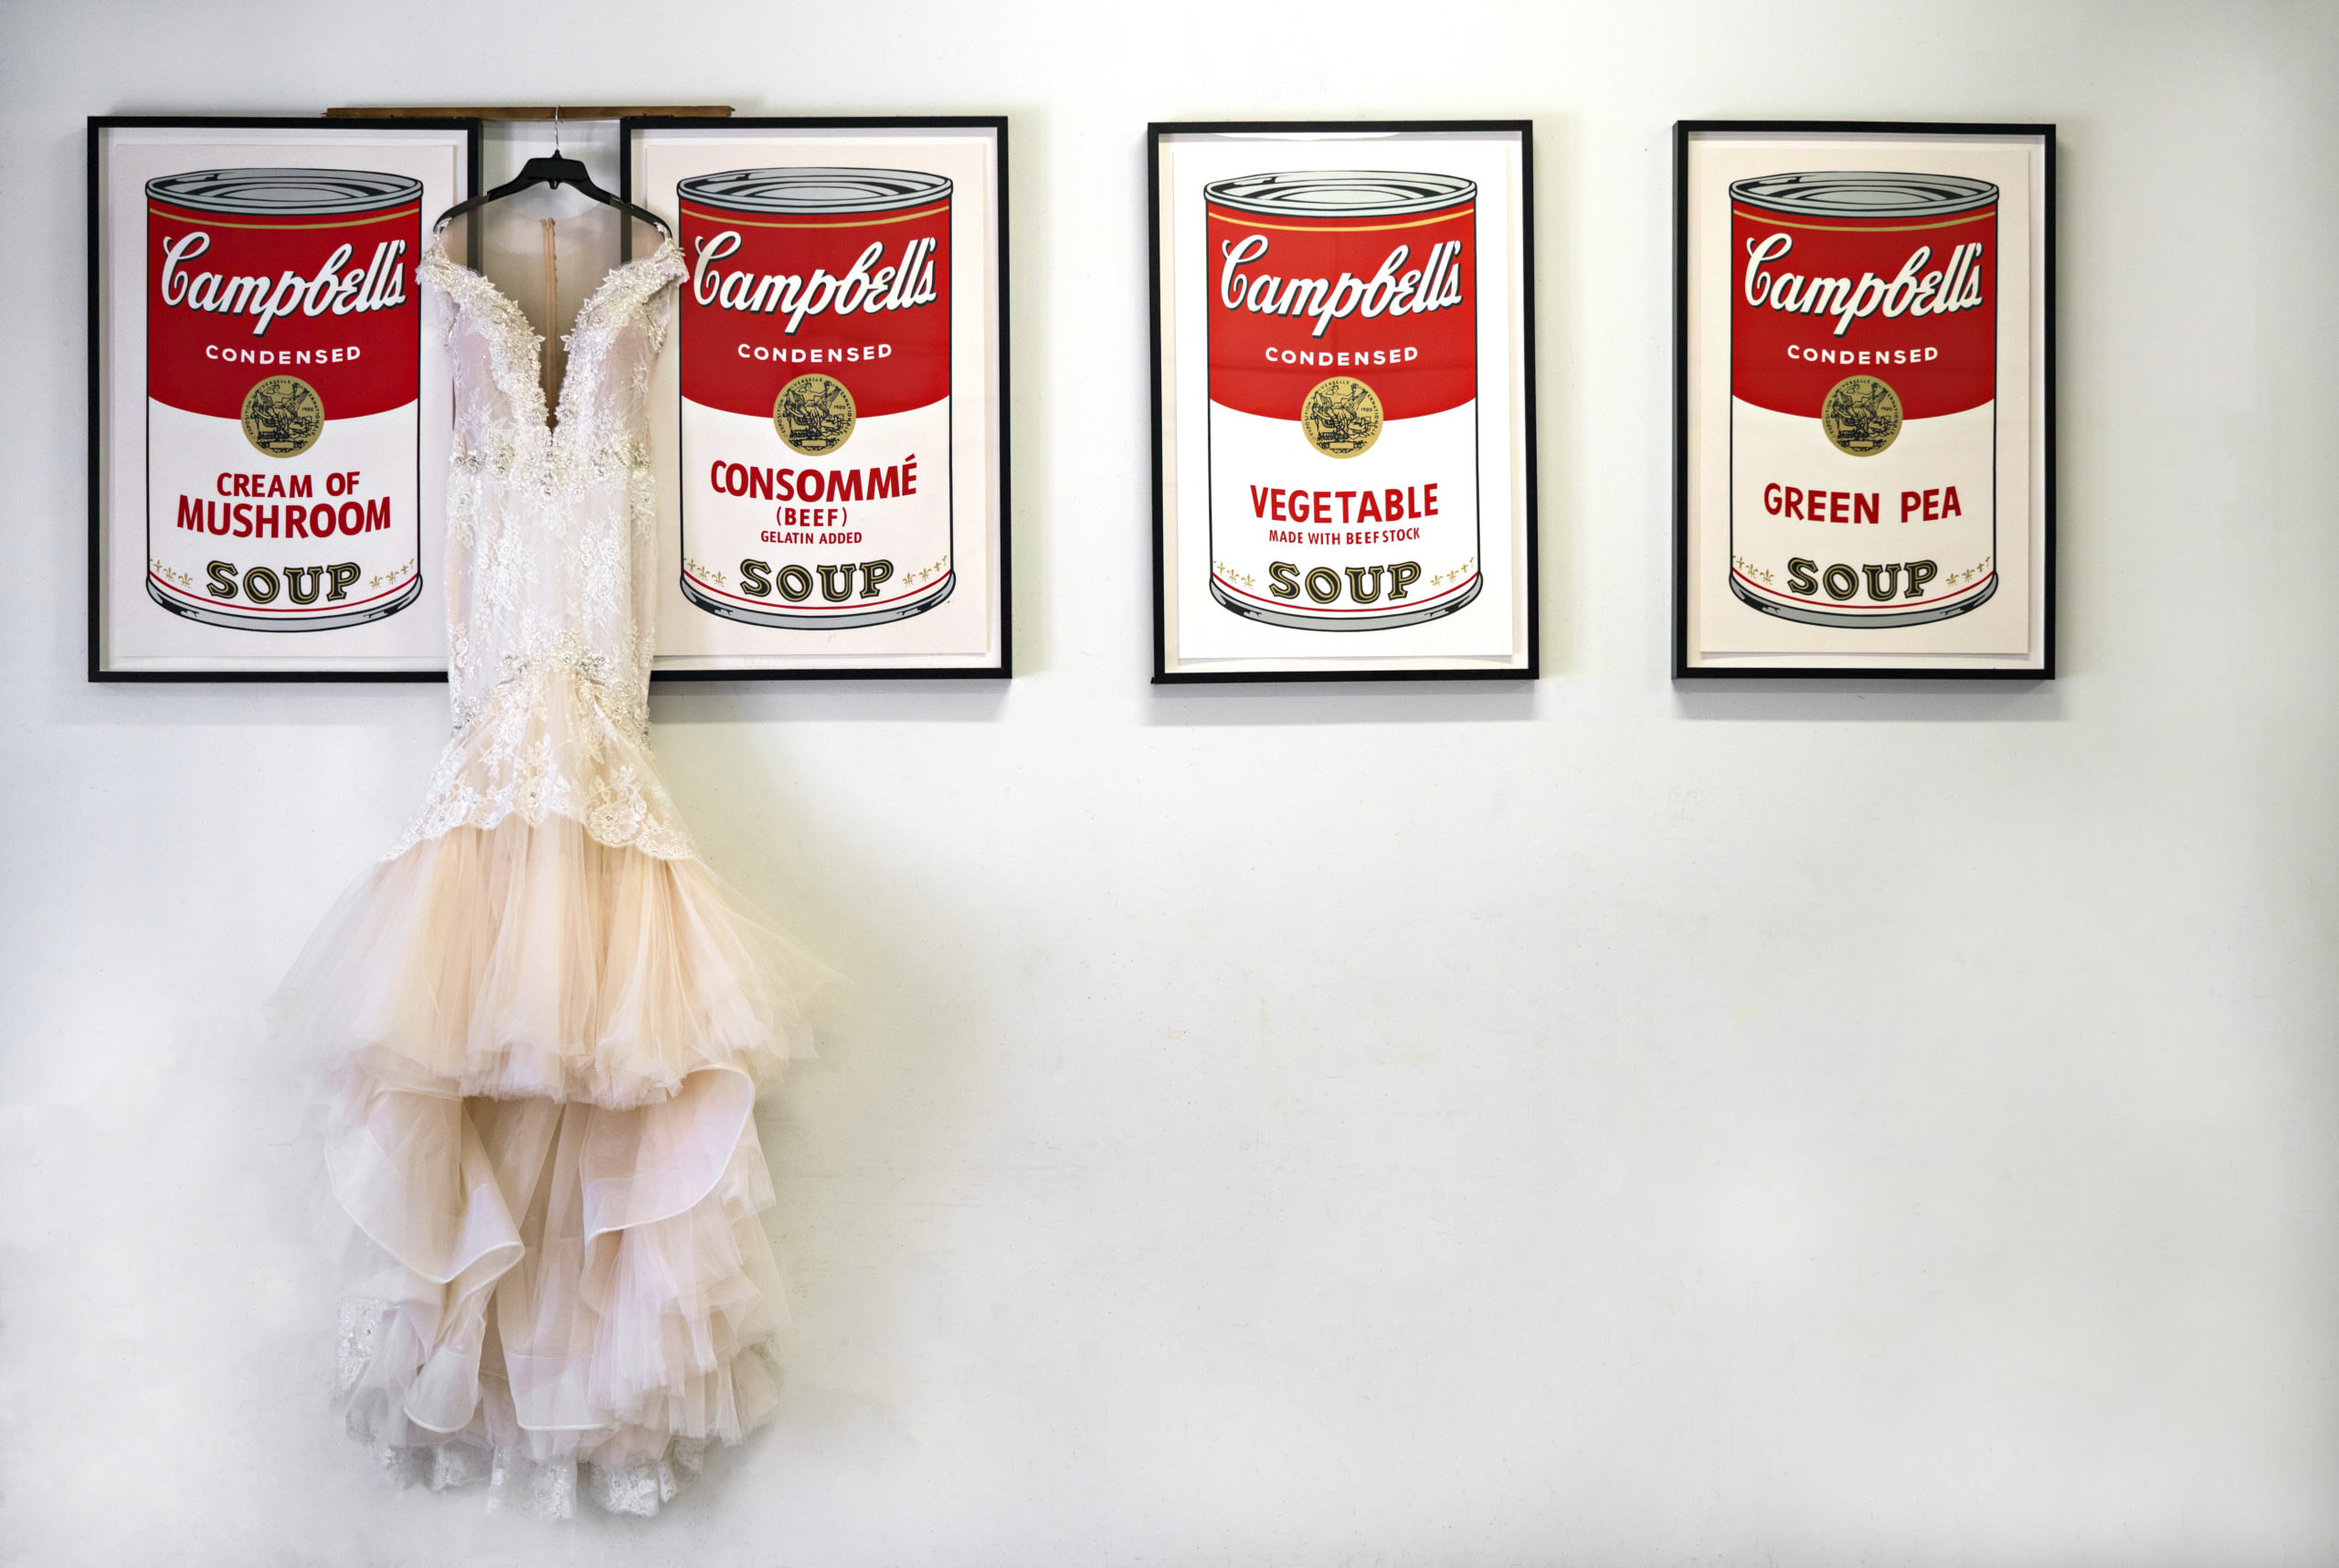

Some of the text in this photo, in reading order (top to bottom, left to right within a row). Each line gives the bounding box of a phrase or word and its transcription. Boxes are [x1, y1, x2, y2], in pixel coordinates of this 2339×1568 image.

[160, 231, 407, 337] Campbell's
[693, 230, 938, 336] Campbell's
[1220, 234, 1464, 338] Campbell's
[1743, 232, 1984, 337] Campbell's
[206, 344, 361, 365] CONDENSED
[737, 343, 892, 364] CONDENSED
[1265, 346, 1418, 366] CONDENSED
[1787, 344, 1938, 365] CONDENSED
[216, 471, 361, 499] CREAM OF
[710, 452, 918, 503] CONSOMMÉ
[176, 493, 391, 539] MUSHROOM
[776, 505, 848, 527] (BEEF)
[1249, 482, 1439, 524] VEGETABLE
[1763, 482, 1963, 525] GREEN PEA
[760, 529, 863, 546] GELATIN ADDED
[1268, 529, 1304, 545] MADE
[1307, 532, 1341, 546] WITH
[206, 560, 362, 605] SOUP
[739, 558, 894, 603] SOUP
[1268, 560, 1423, 605] SOUP
[1786, 556, 1938, 601] SOUP
